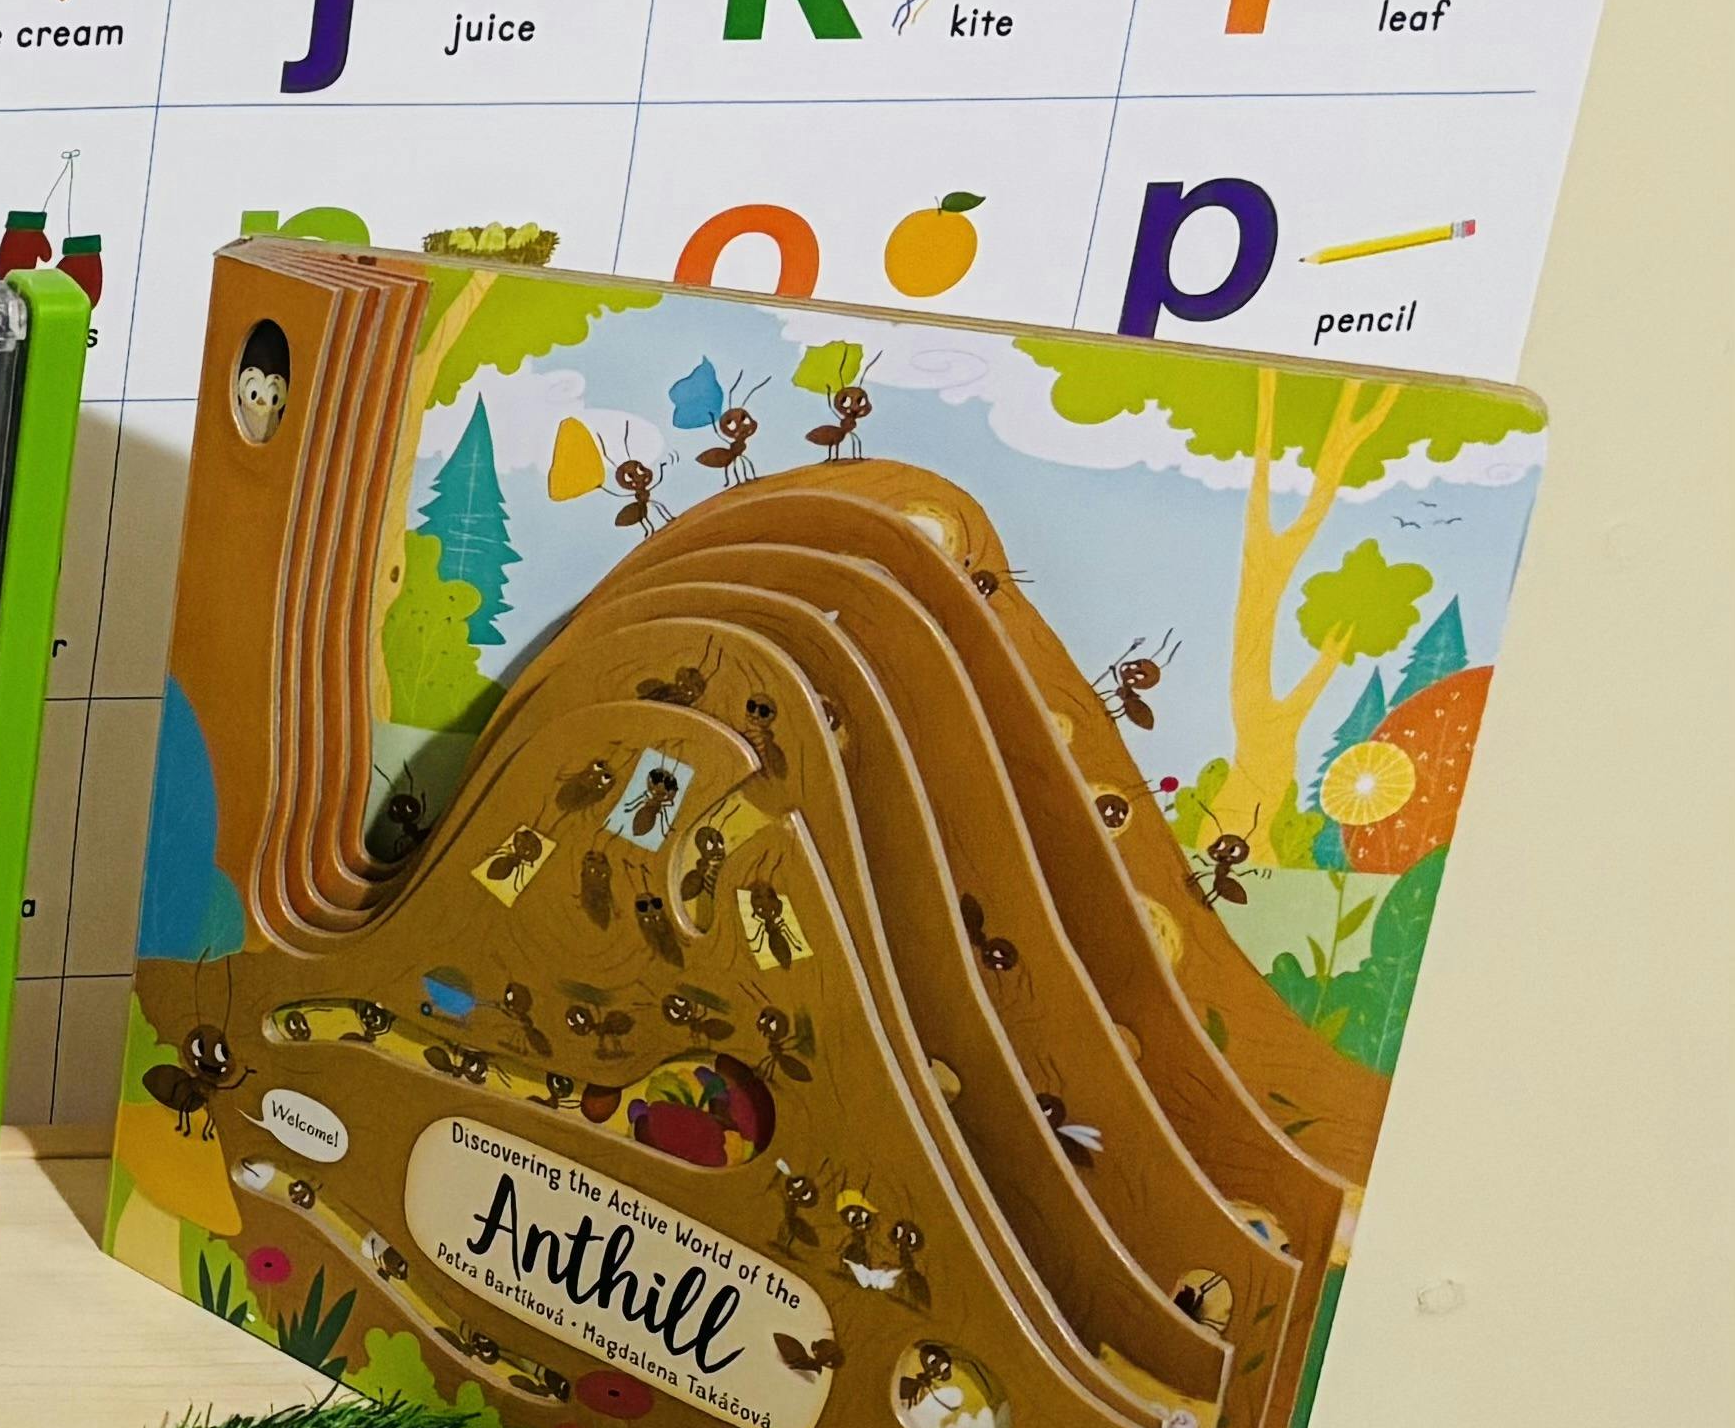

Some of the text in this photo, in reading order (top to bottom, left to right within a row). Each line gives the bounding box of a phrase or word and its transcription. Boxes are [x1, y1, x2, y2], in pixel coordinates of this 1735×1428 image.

[16, 24, 124, 49] cream
[443, 12, 536, 56] juice
[950, 3, 1014, 38] kite
[1118, 174, 1281, 338] p
[1313, 299, 1418, 347] pencil
[271, 1099, 339, 1148] Welcome!
[452, 1121, 801, 1309] Discovering the Active World of the
[466, 1173, 746, 1375] Anthill
[437, 1242, 478, 1279] Petra
[583, 1321, 679, 1387] Magdalena
